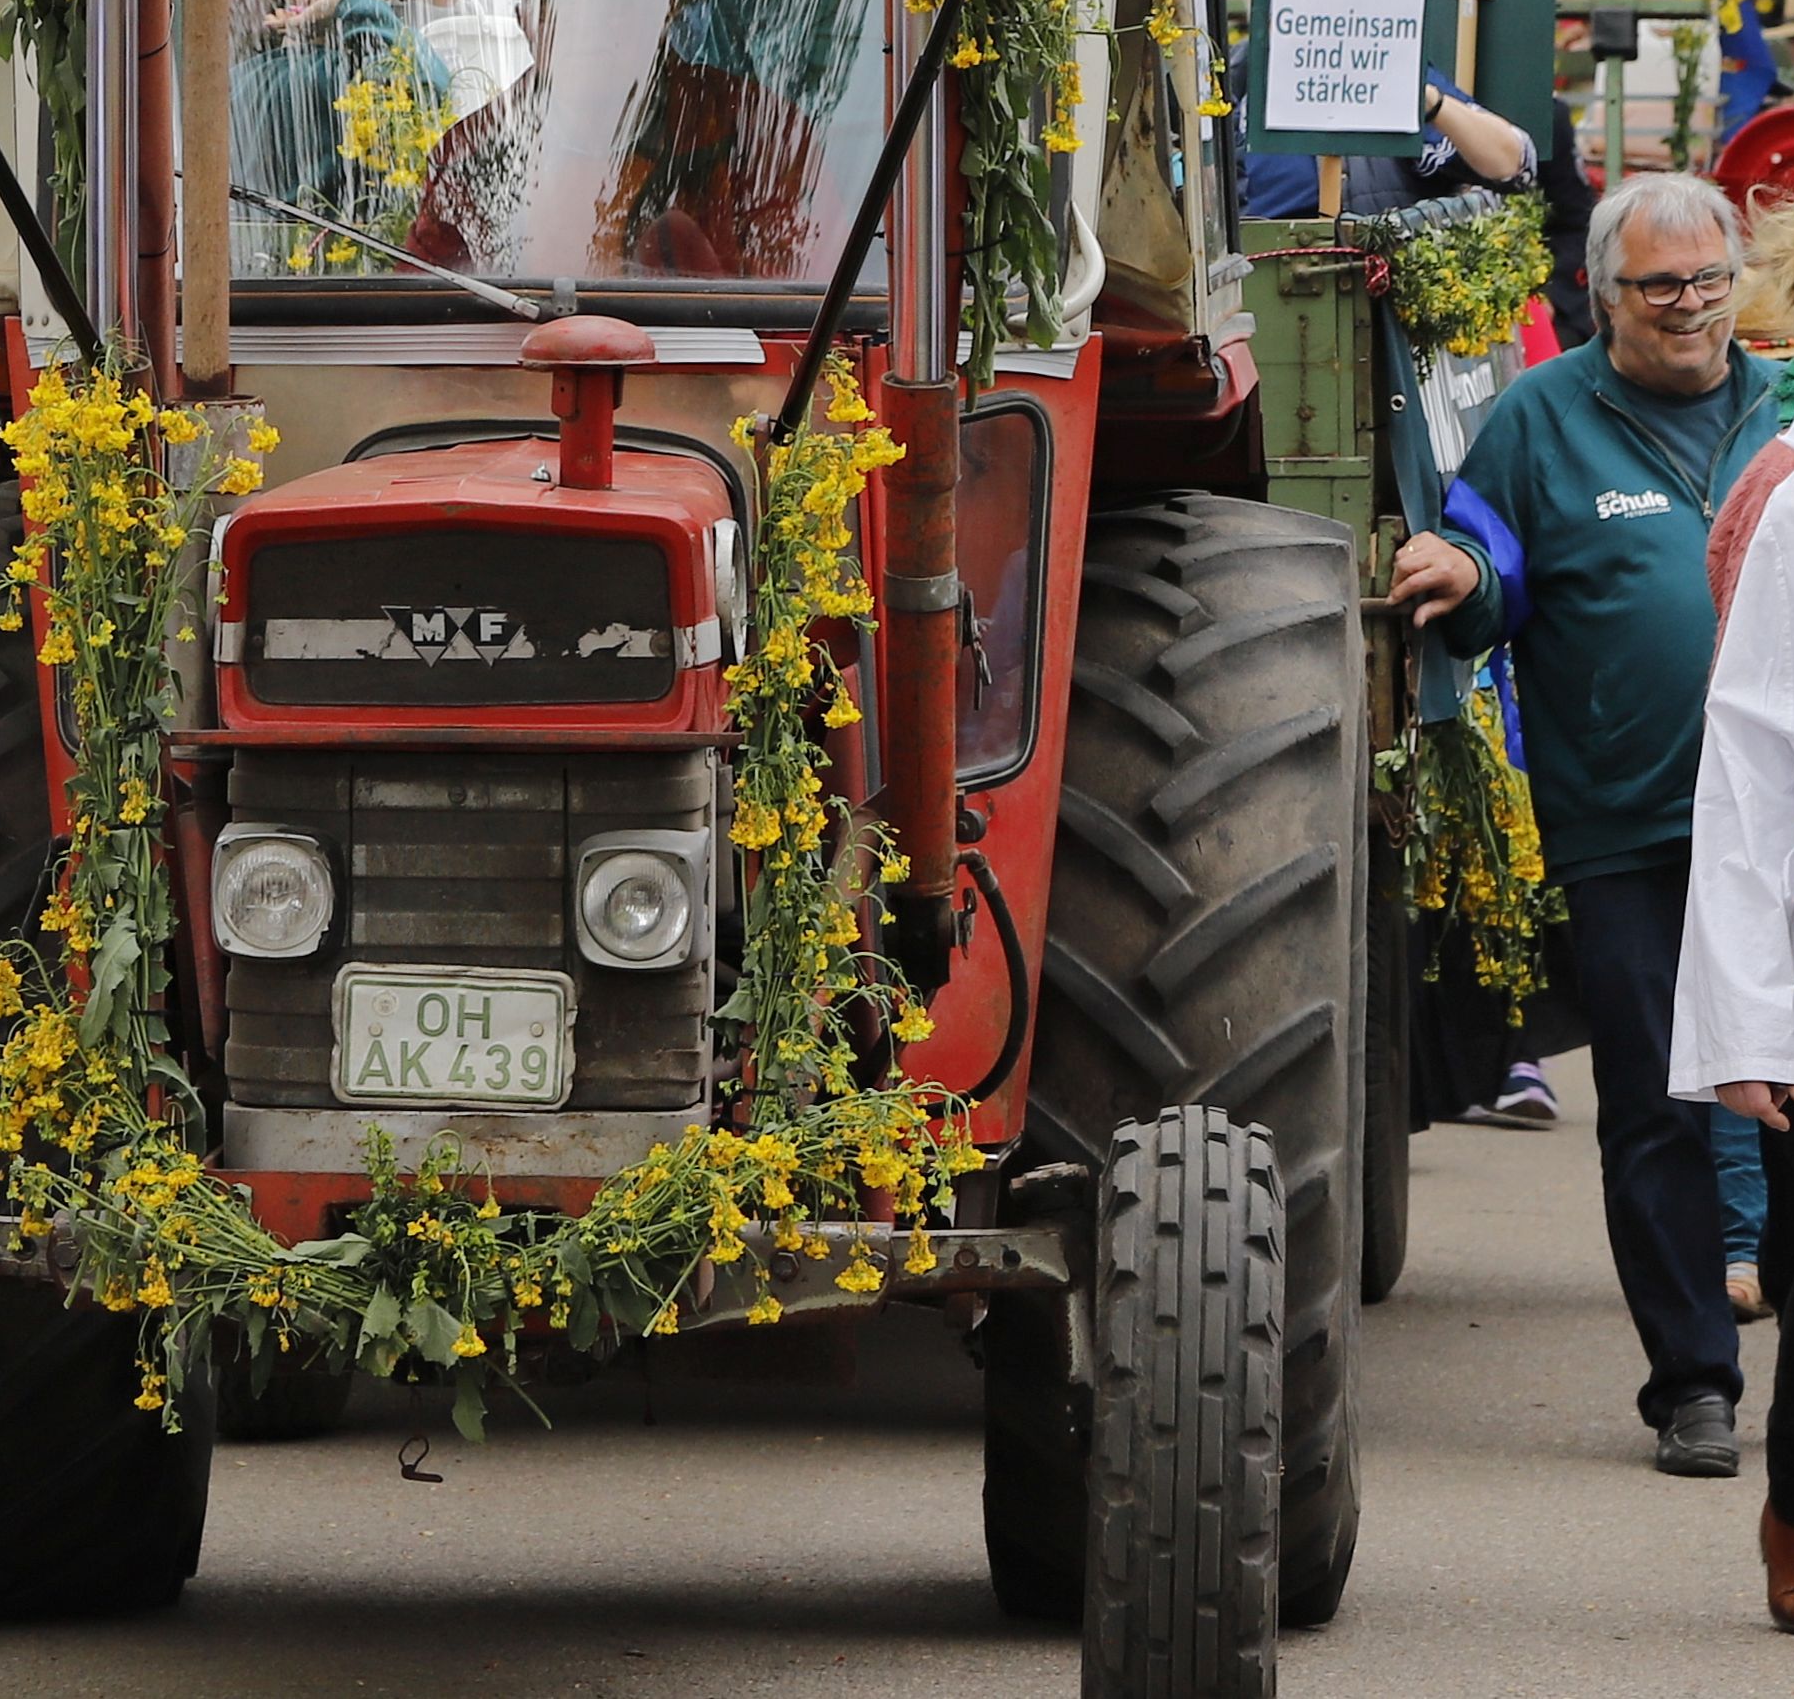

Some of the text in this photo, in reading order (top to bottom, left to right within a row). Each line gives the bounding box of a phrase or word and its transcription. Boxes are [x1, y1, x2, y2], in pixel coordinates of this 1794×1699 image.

[1275, 7, 1417, 39] Gemeinsam
[1294, 40, 1389, 70] sind wir
[1295, 74, 1380, 104] stärker
[1597, 489, 1669, 520] schule
[417, 992, 491, 1040] OH
[356, 1039, 548, 1091] AK 439
